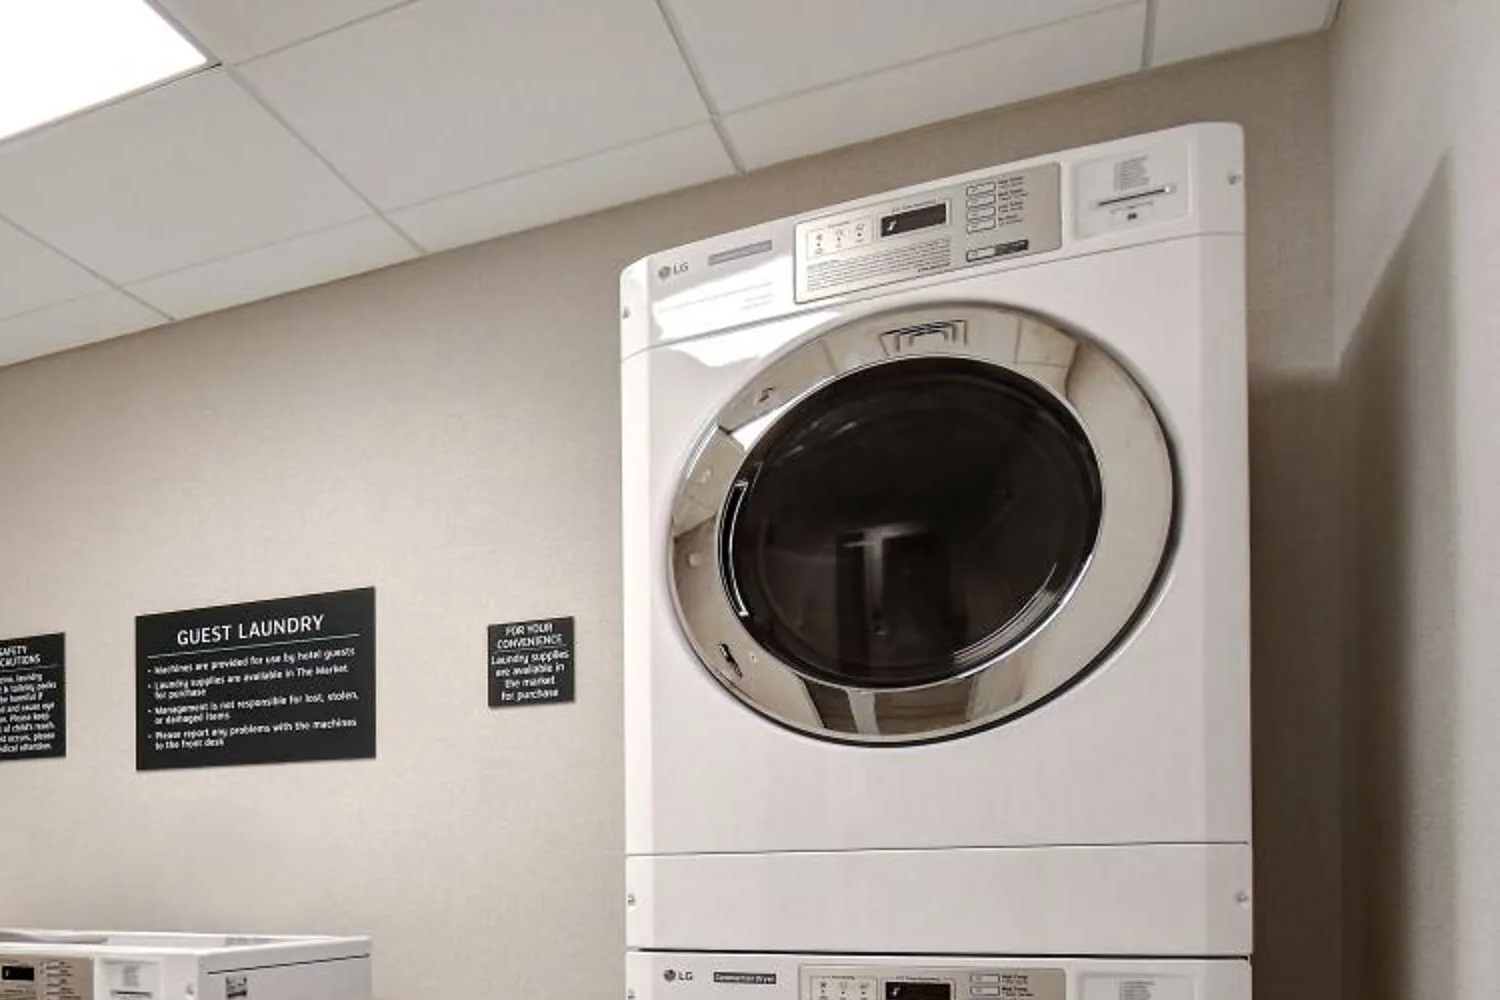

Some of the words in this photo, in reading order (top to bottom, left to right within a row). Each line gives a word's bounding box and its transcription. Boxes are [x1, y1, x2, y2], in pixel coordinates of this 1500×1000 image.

[674, 262, 689, 275] LG
[177, 625, 232, 645] GUEST
[239, 614, 324, 639] LAUNDRY
[497, 634, 562, 648] CONVENIENCE
[154, 664, 193, 675] Machines
[196, 662, 208, 671] are
[211, 657, 248, 671] provided
[250, 656, 264, 665] for
[266, 656, 282, 664] use
[284, 652, 295, 664] by
[298, 650, 322, 661] hotel
[324, 647, 355, 661] guests
[492, 655, 528, 664] Laundry
[556, 661, 564, 672] in
[154, 678, 189, 691] Laundry
[190, 676, 224, 688] supplies
[228, 674, 241, 683] are
[244, 670, 282, 682] available
[286, 669, 294, 678] in
[297, 667, 314, 678] The
[316, 664, 348, 674] Market
[154, 689, 166, 699] for
[169, 688, 206, 699] purchase
[154, 703, 208, 716] Management
[210, 702, 218, 711] is
[220, 700, 235, 710] not
[237, 696, 287, 709] responsible
[289, 694, 302, 705] for
[154, 716, 163, 725] or
[165, 714, 203, 726] damaged
[155, 731, 181, 740] Please
[184, 729, 209, 740] report
[212, 728, 227, 738] any
[230, 723, 270, 737] problems
[273, 722, 293, 733] with
[295, 720, 311, 731] the
[313, 718, 356, 729] machines
[155, 741, 164, 750] to
[166, 739, 179, 749] the
[181, 738, 202, 748] front
[204, 737, 224, 747] desk
[678, 971, 693, 981] LG
